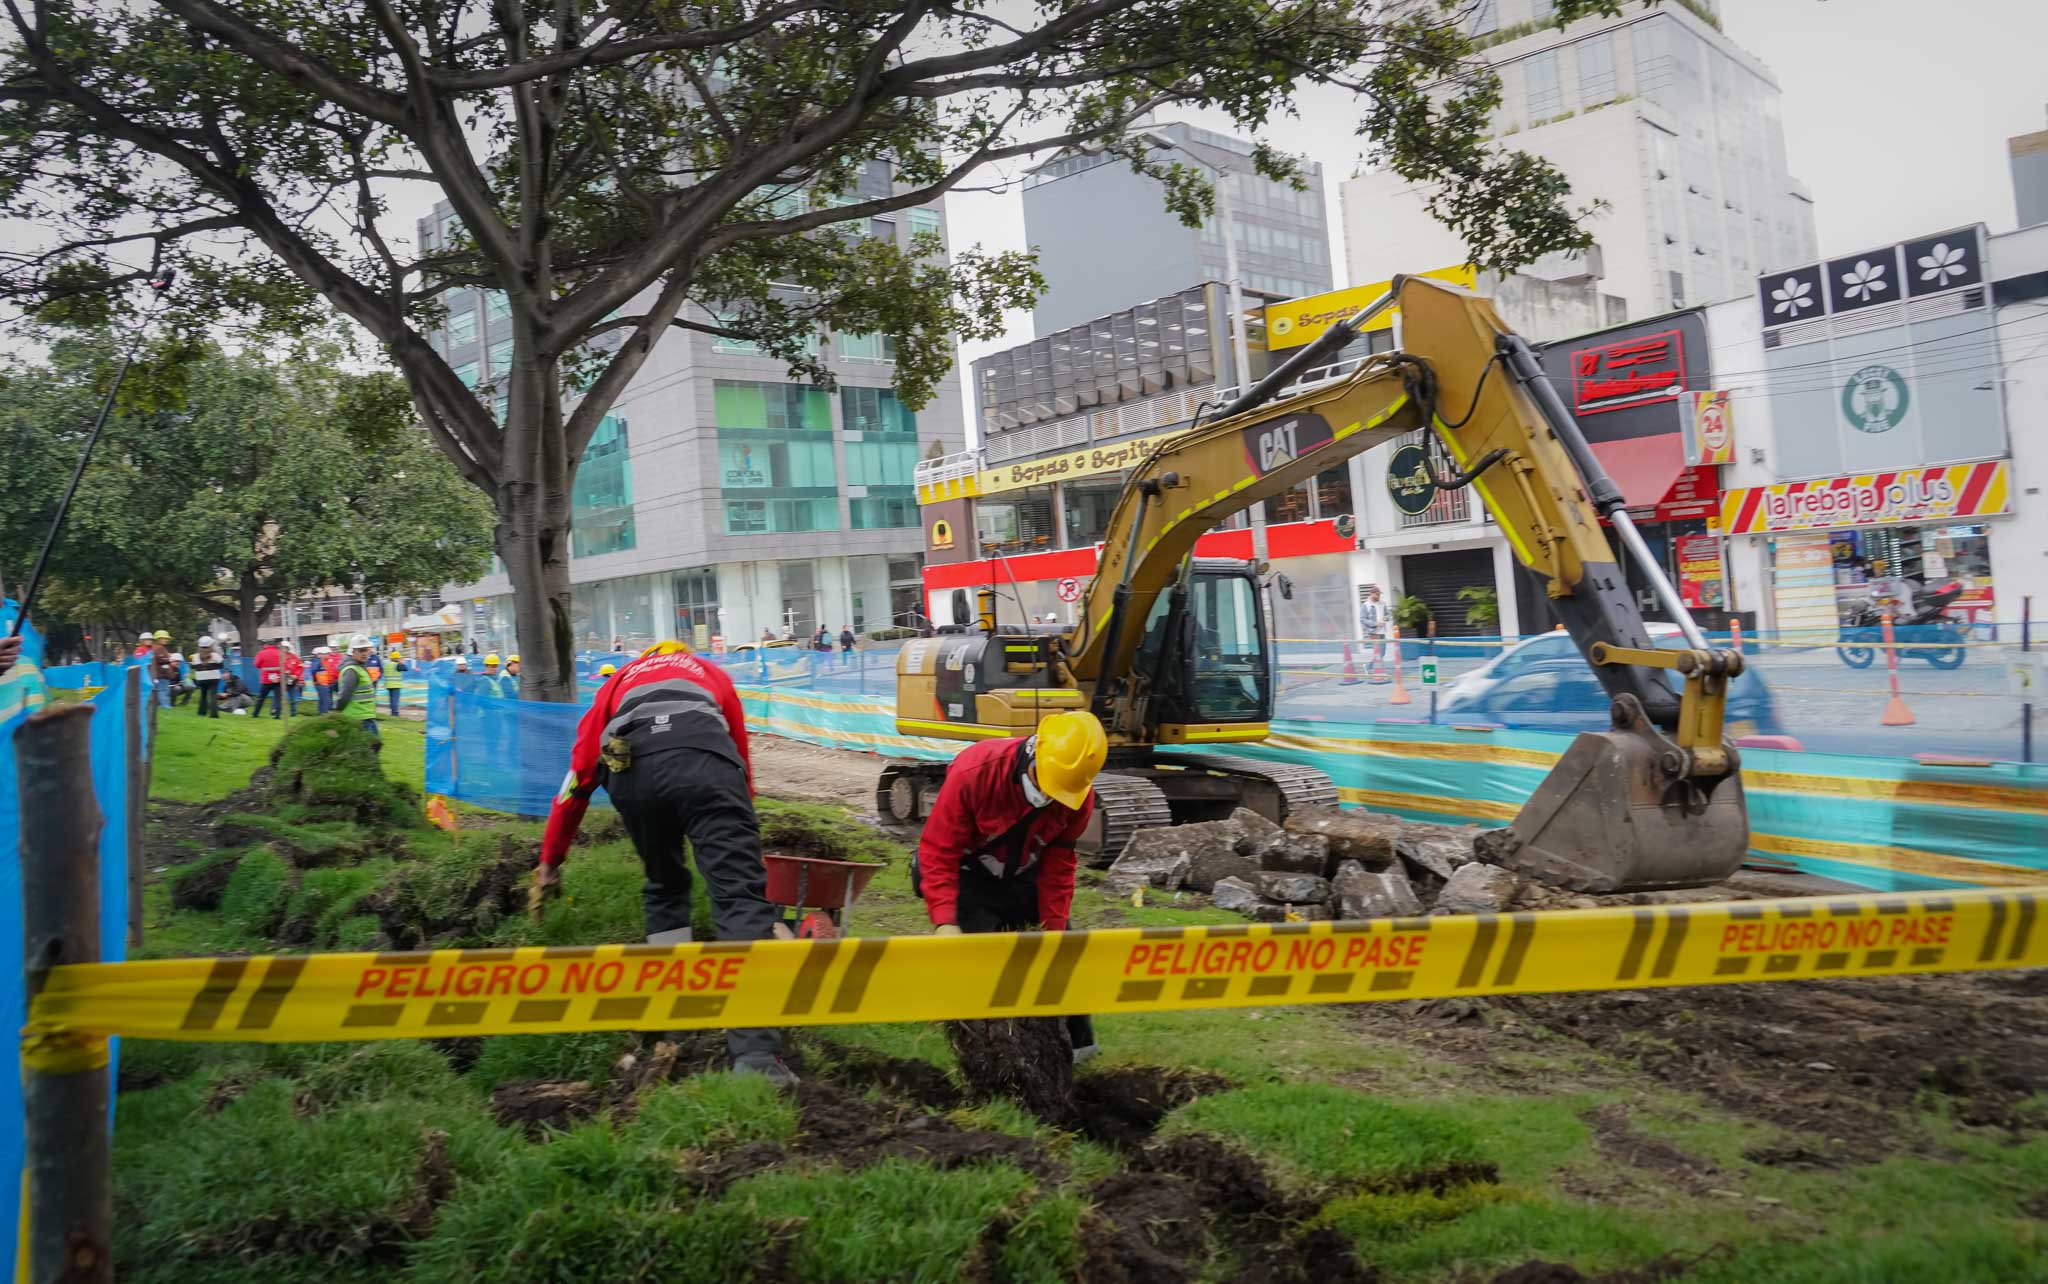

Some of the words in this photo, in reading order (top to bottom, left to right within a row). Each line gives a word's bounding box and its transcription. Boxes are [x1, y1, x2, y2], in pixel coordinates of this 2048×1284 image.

[1703, 415, 1724, 434] 24
[1258, 420, 1299, 472] CAT
[1011, 457, 1070, 483] Sopas
[1794, 485, 1876, 518] rebaja
[1887, 475, 1952, 511] plus
[1718, 919, 1839, 953] PELIGRO
[1842, 917, 1885, 949] NO
[1886, 915, 1954, 946] PASE
[1123, 938, 1279, 976] PELIGRO
[1284, 937, 1337, 972] NO
[1341, 935, 1428, 969] PASE
[353, 962, 551, 999] PELIGRO
[560, 960, 625, 995] NO
[633, 956, 748, 992] PASE
